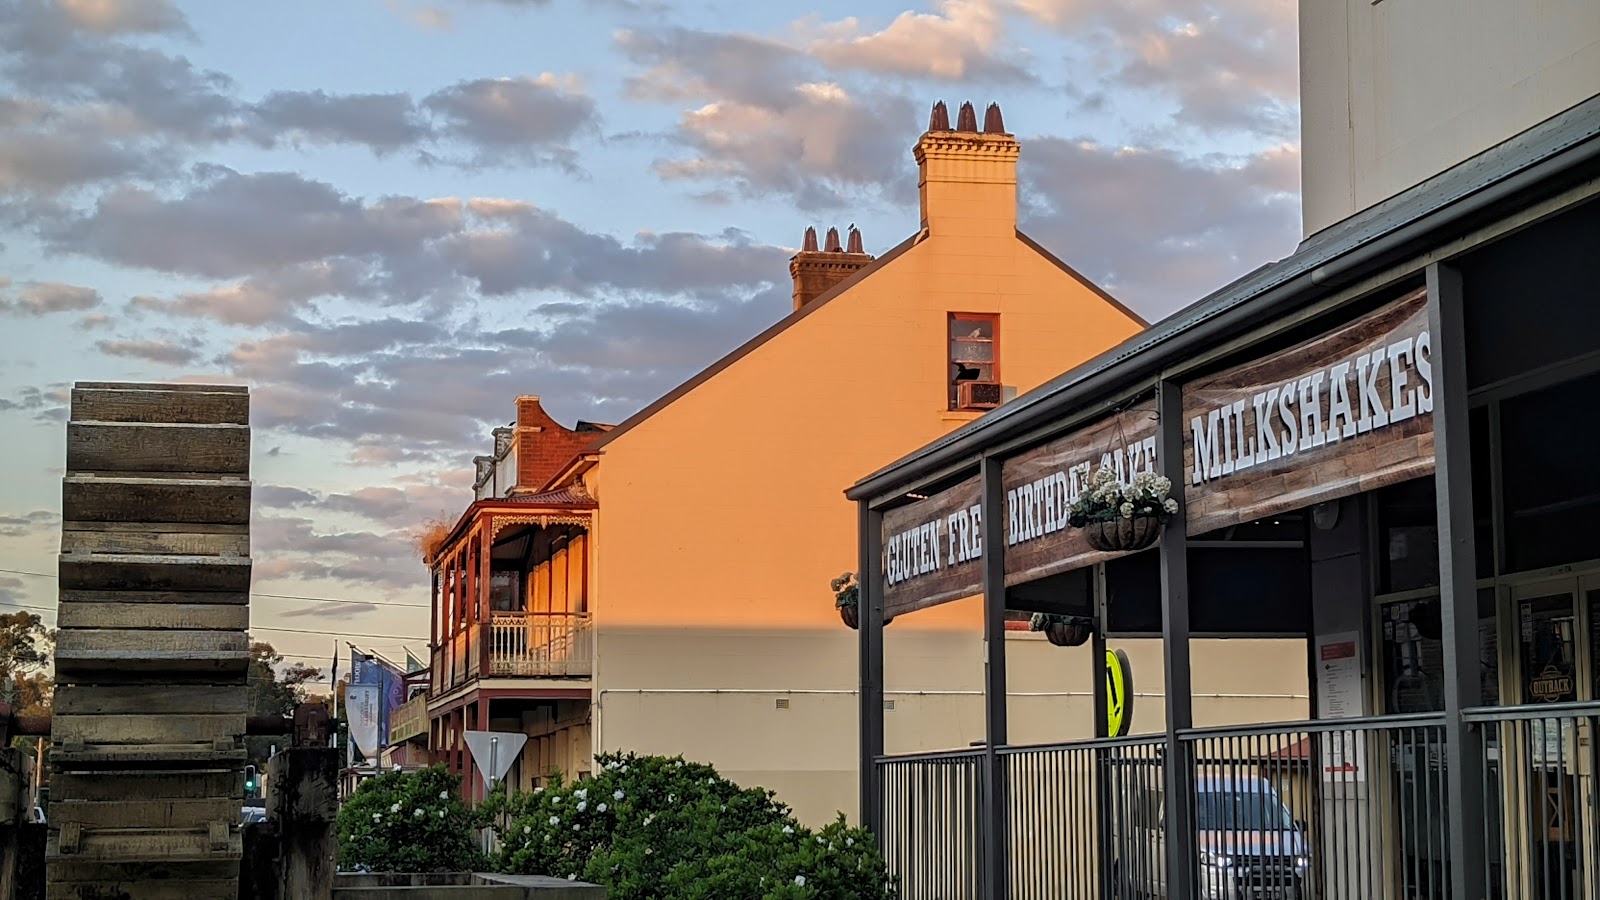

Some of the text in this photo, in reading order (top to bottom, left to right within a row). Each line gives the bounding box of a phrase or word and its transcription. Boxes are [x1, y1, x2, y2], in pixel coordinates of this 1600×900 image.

[1191, 331, 1434, 485] MILKSHAKES
[887, 519, 942, 586] GLUTEN
[1533, 678, 1570, 695] OUTBACK
